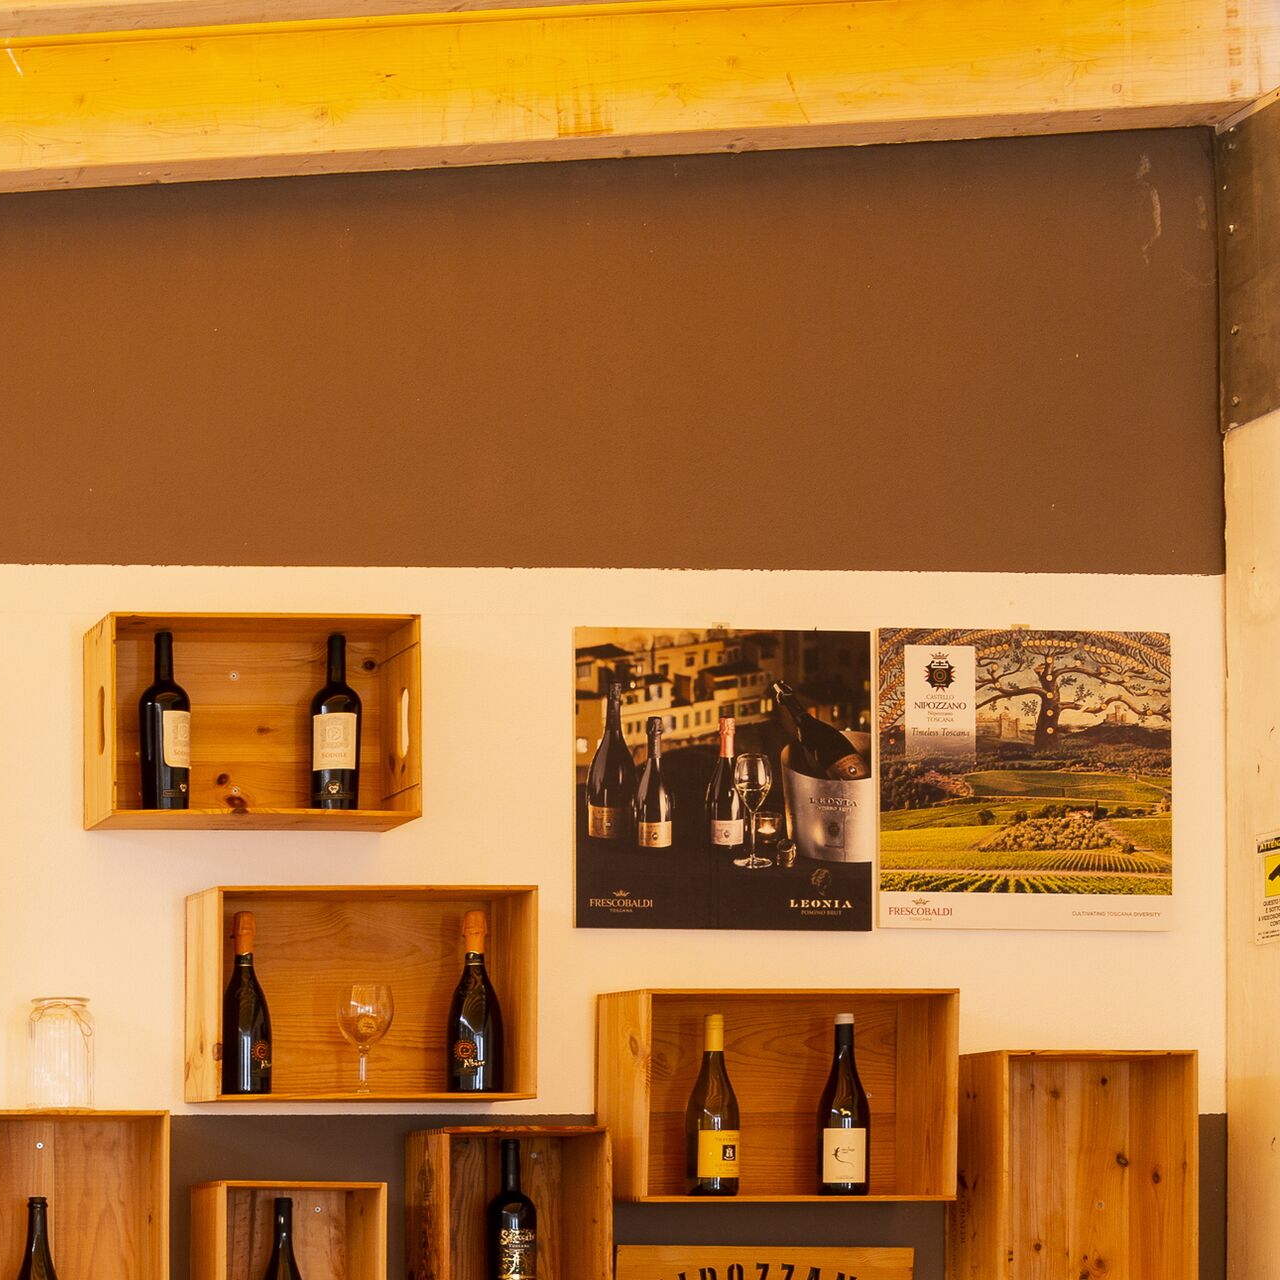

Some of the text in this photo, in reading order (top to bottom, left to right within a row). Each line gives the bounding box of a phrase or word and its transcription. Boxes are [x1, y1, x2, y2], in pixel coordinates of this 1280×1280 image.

[914, 701, 967, 710] NIPOZZANO
[911, 727, 970, 737] Timeless Toscana
[809, 796, 858, 807] LEONIA
[589, 898, 654, 908] FRESCOBALDI
[789, 899, 853, 908] LEONIA
[888, 906, 953, 916] FRESCOBALDI
